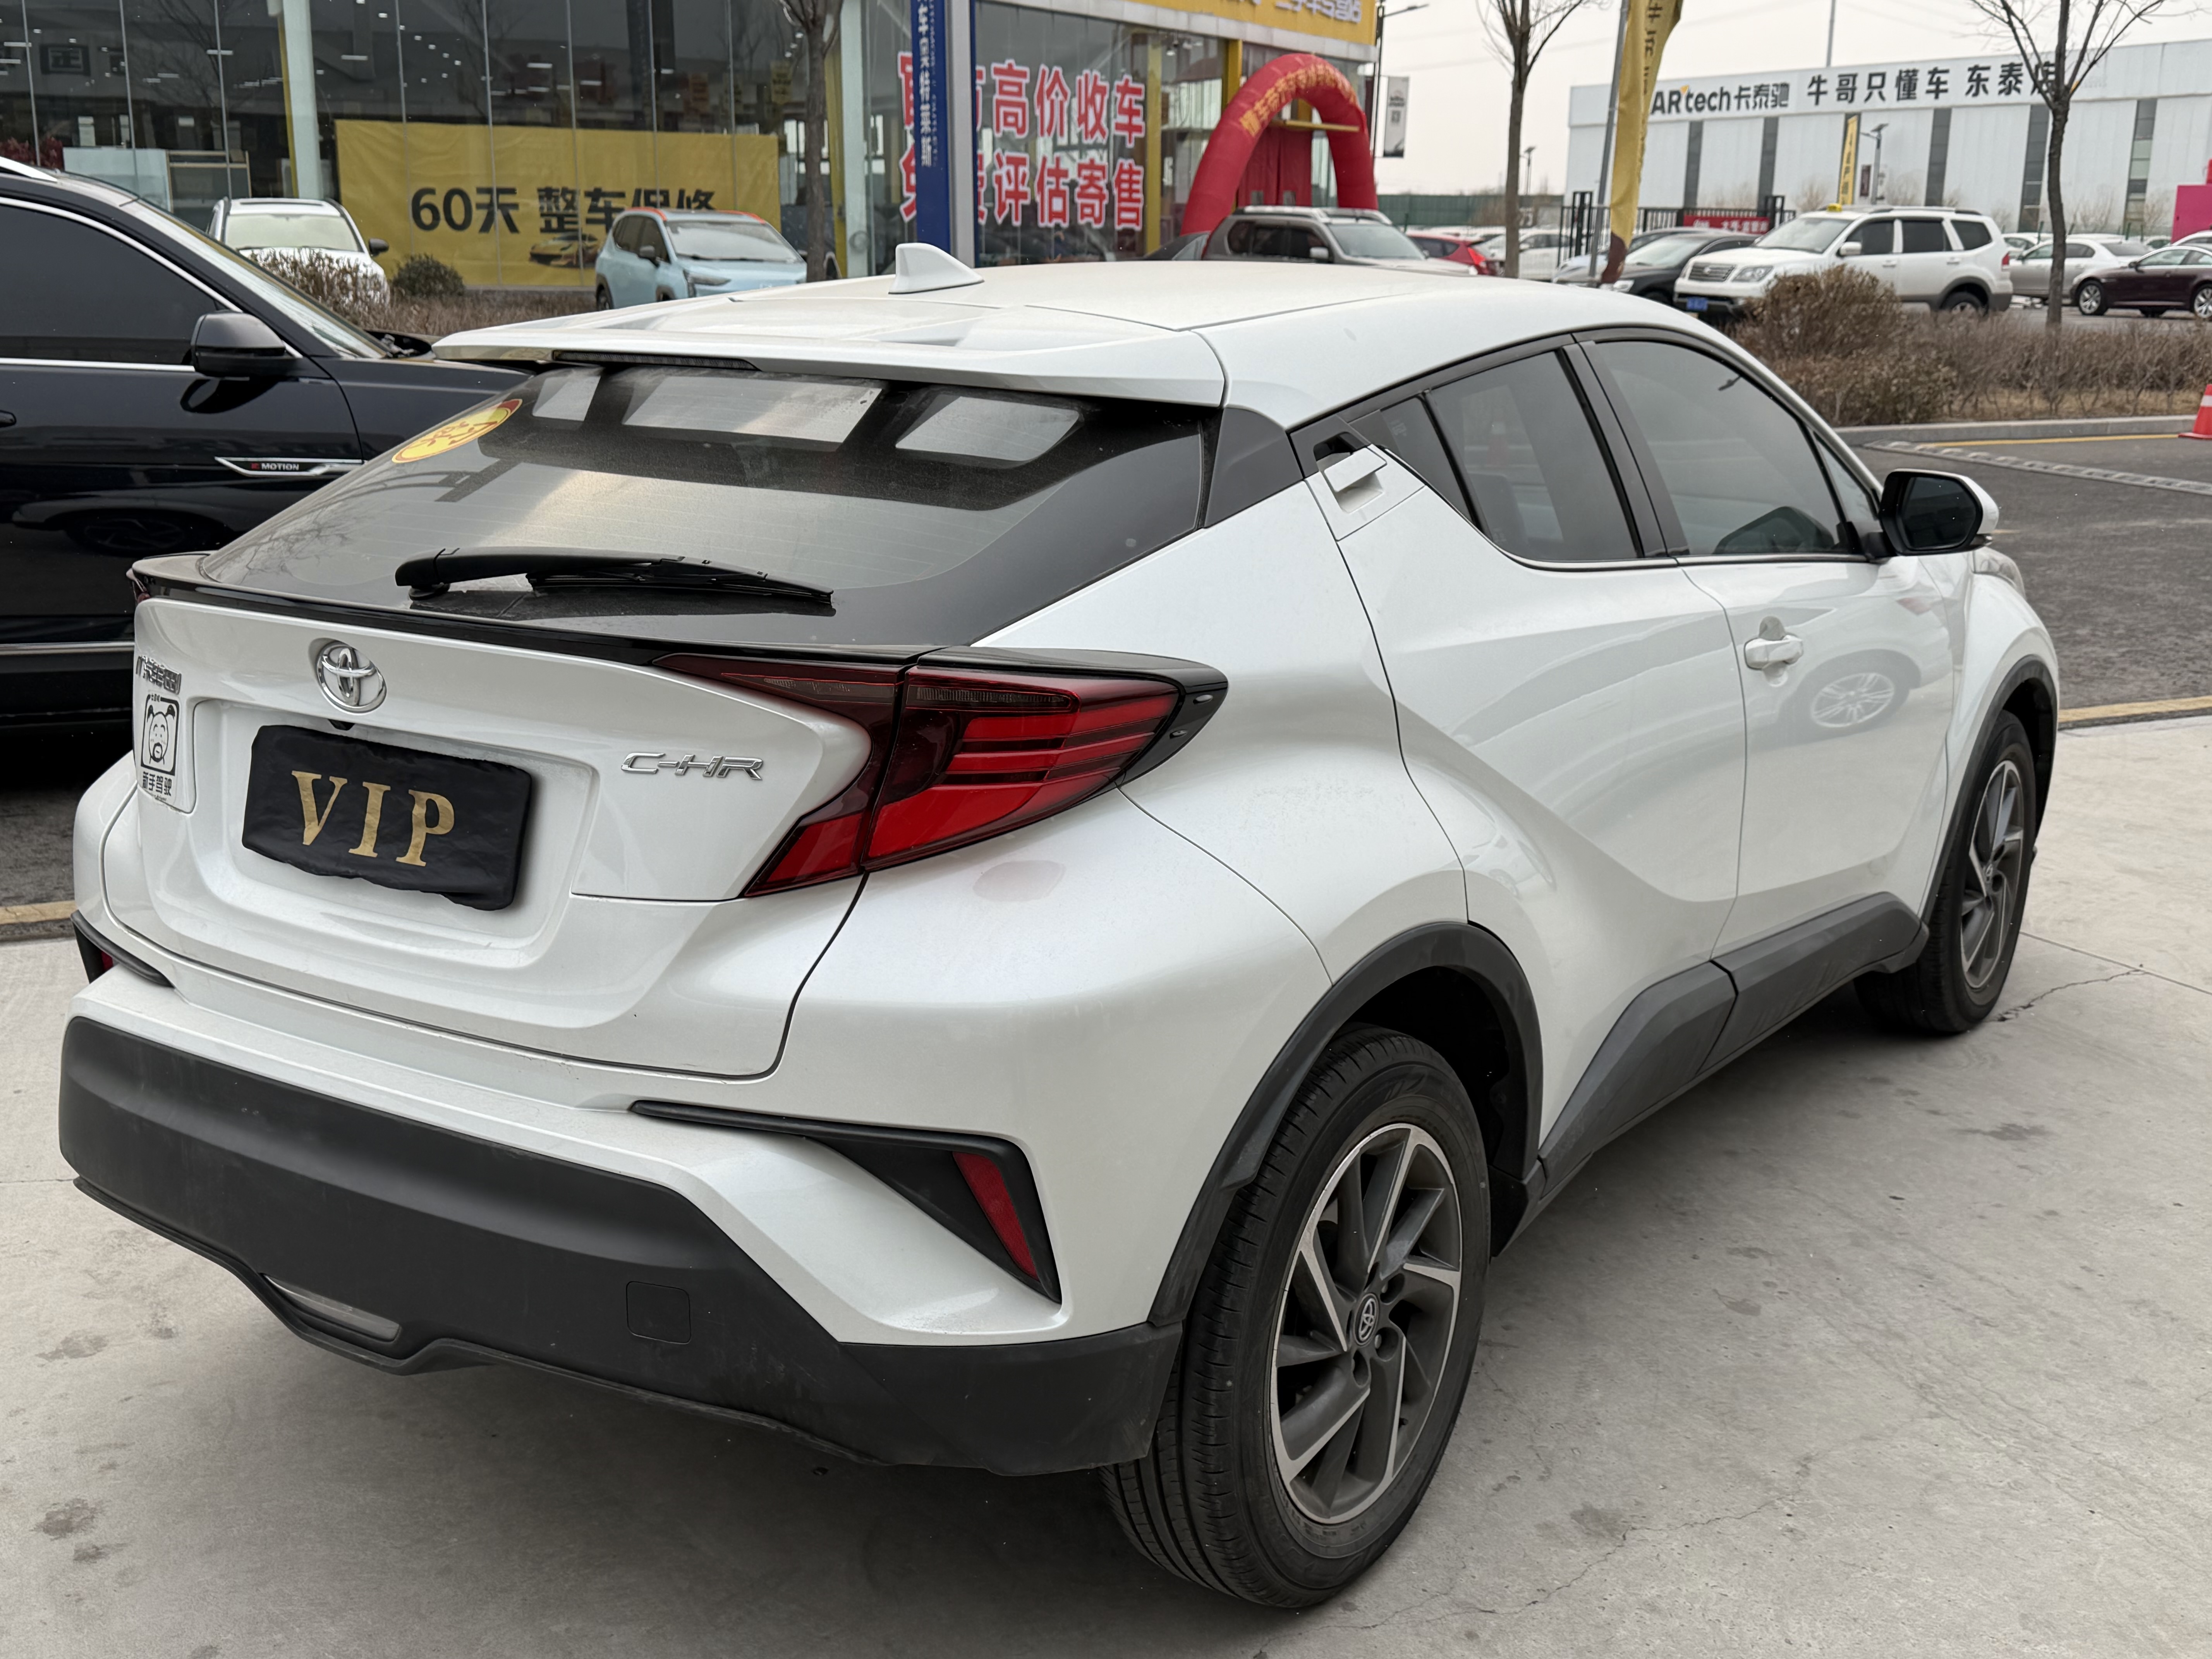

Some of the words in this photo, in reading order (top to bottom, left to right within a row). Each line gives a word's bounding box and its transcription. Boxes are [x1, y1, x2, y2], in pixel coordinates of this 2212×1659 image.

[898, 52, 1145, 148] 高价收车
[1650, 86, 1730, 115] ARtech
[1807, 67, 1950, 105] 牛哥只懂车
[900, 143, 1144, 230] 评估寄售
[411, 187, 520, 234] 60天
[621, 753, 763, 781] C-HR
[292, 771, 455, 866] VIP
